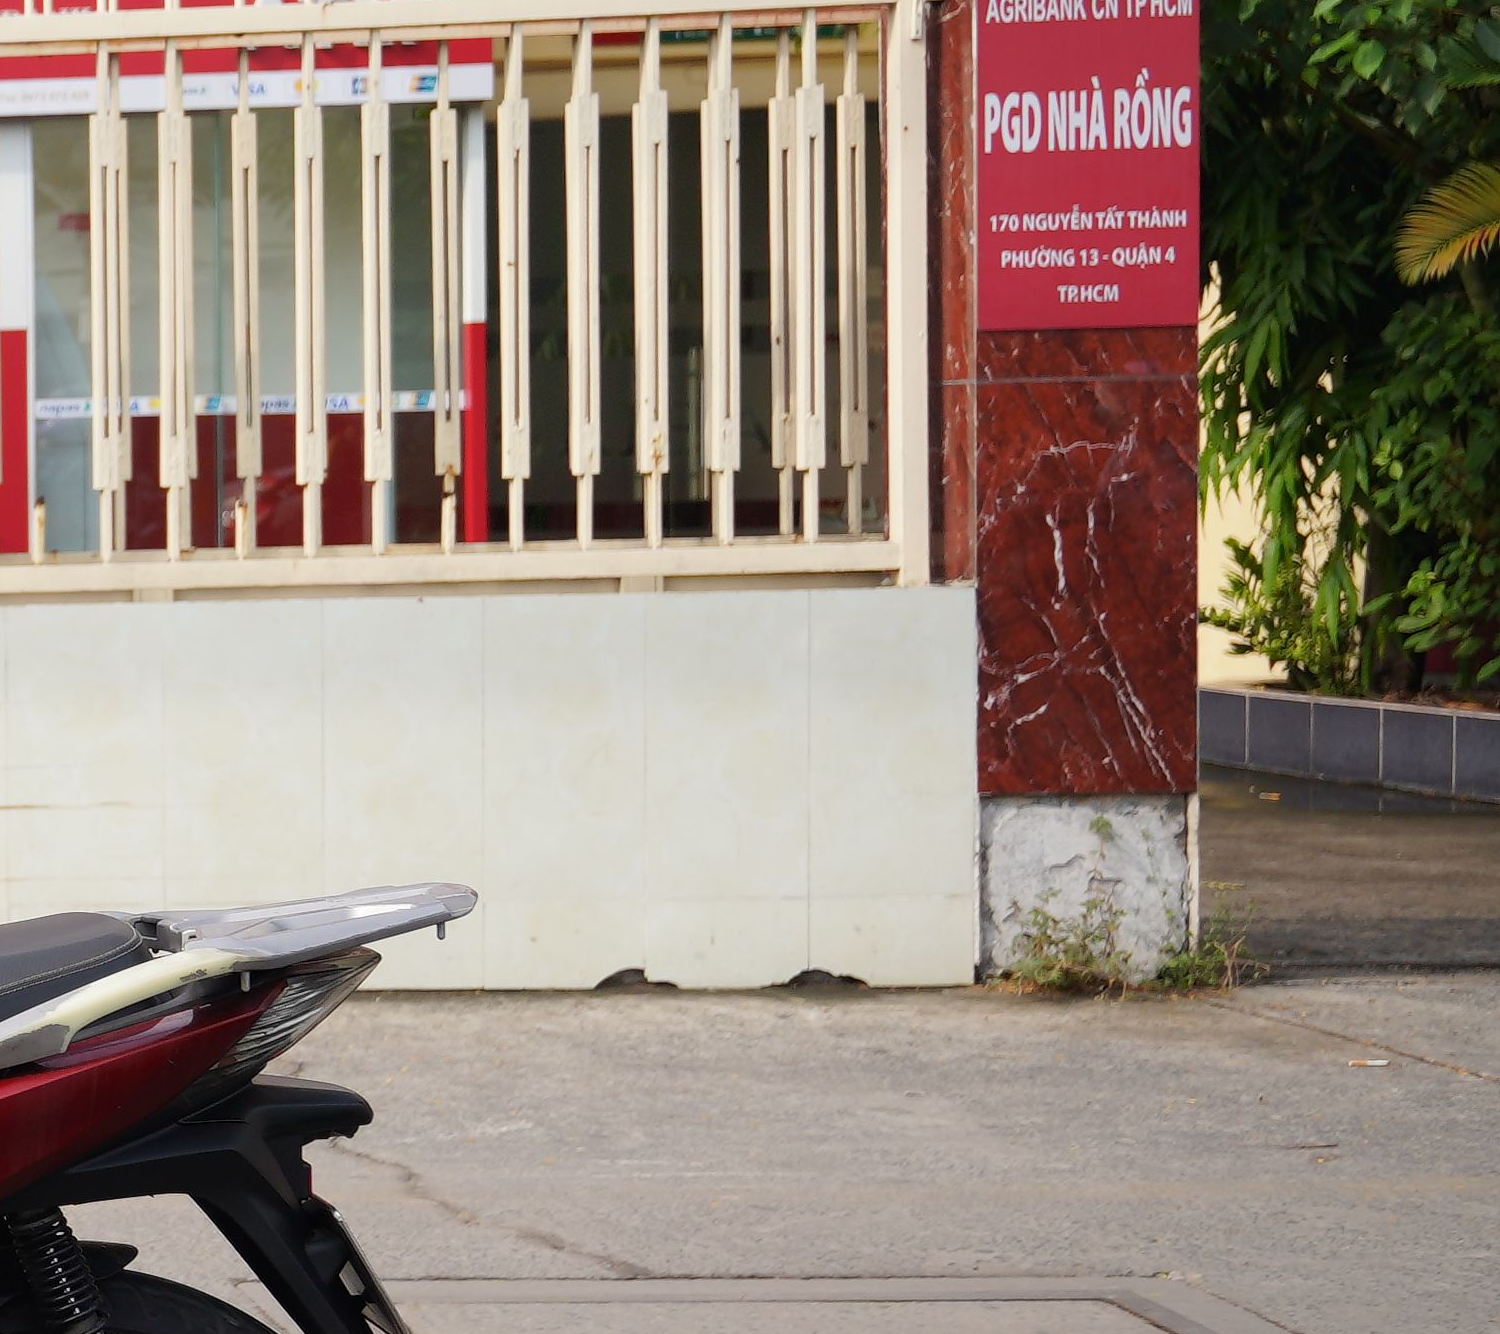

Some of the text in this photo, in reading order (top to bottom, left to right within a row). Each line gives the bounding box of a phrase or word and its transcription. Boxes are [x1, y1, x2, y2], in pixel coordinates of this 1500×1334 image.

[984, 68, 1191, 153] PGD NHÀ RỒNG
[990, 204, 1187, 232] 170 NGUYỄN TẤT THÀNH
[1001, 244, 1075, 268] PHƯỜNG
[1080, 249, 1099, 266] 13
[1112, 243, 1161, 268] QUẬN
[1165, 247, 1176, 263] 4
